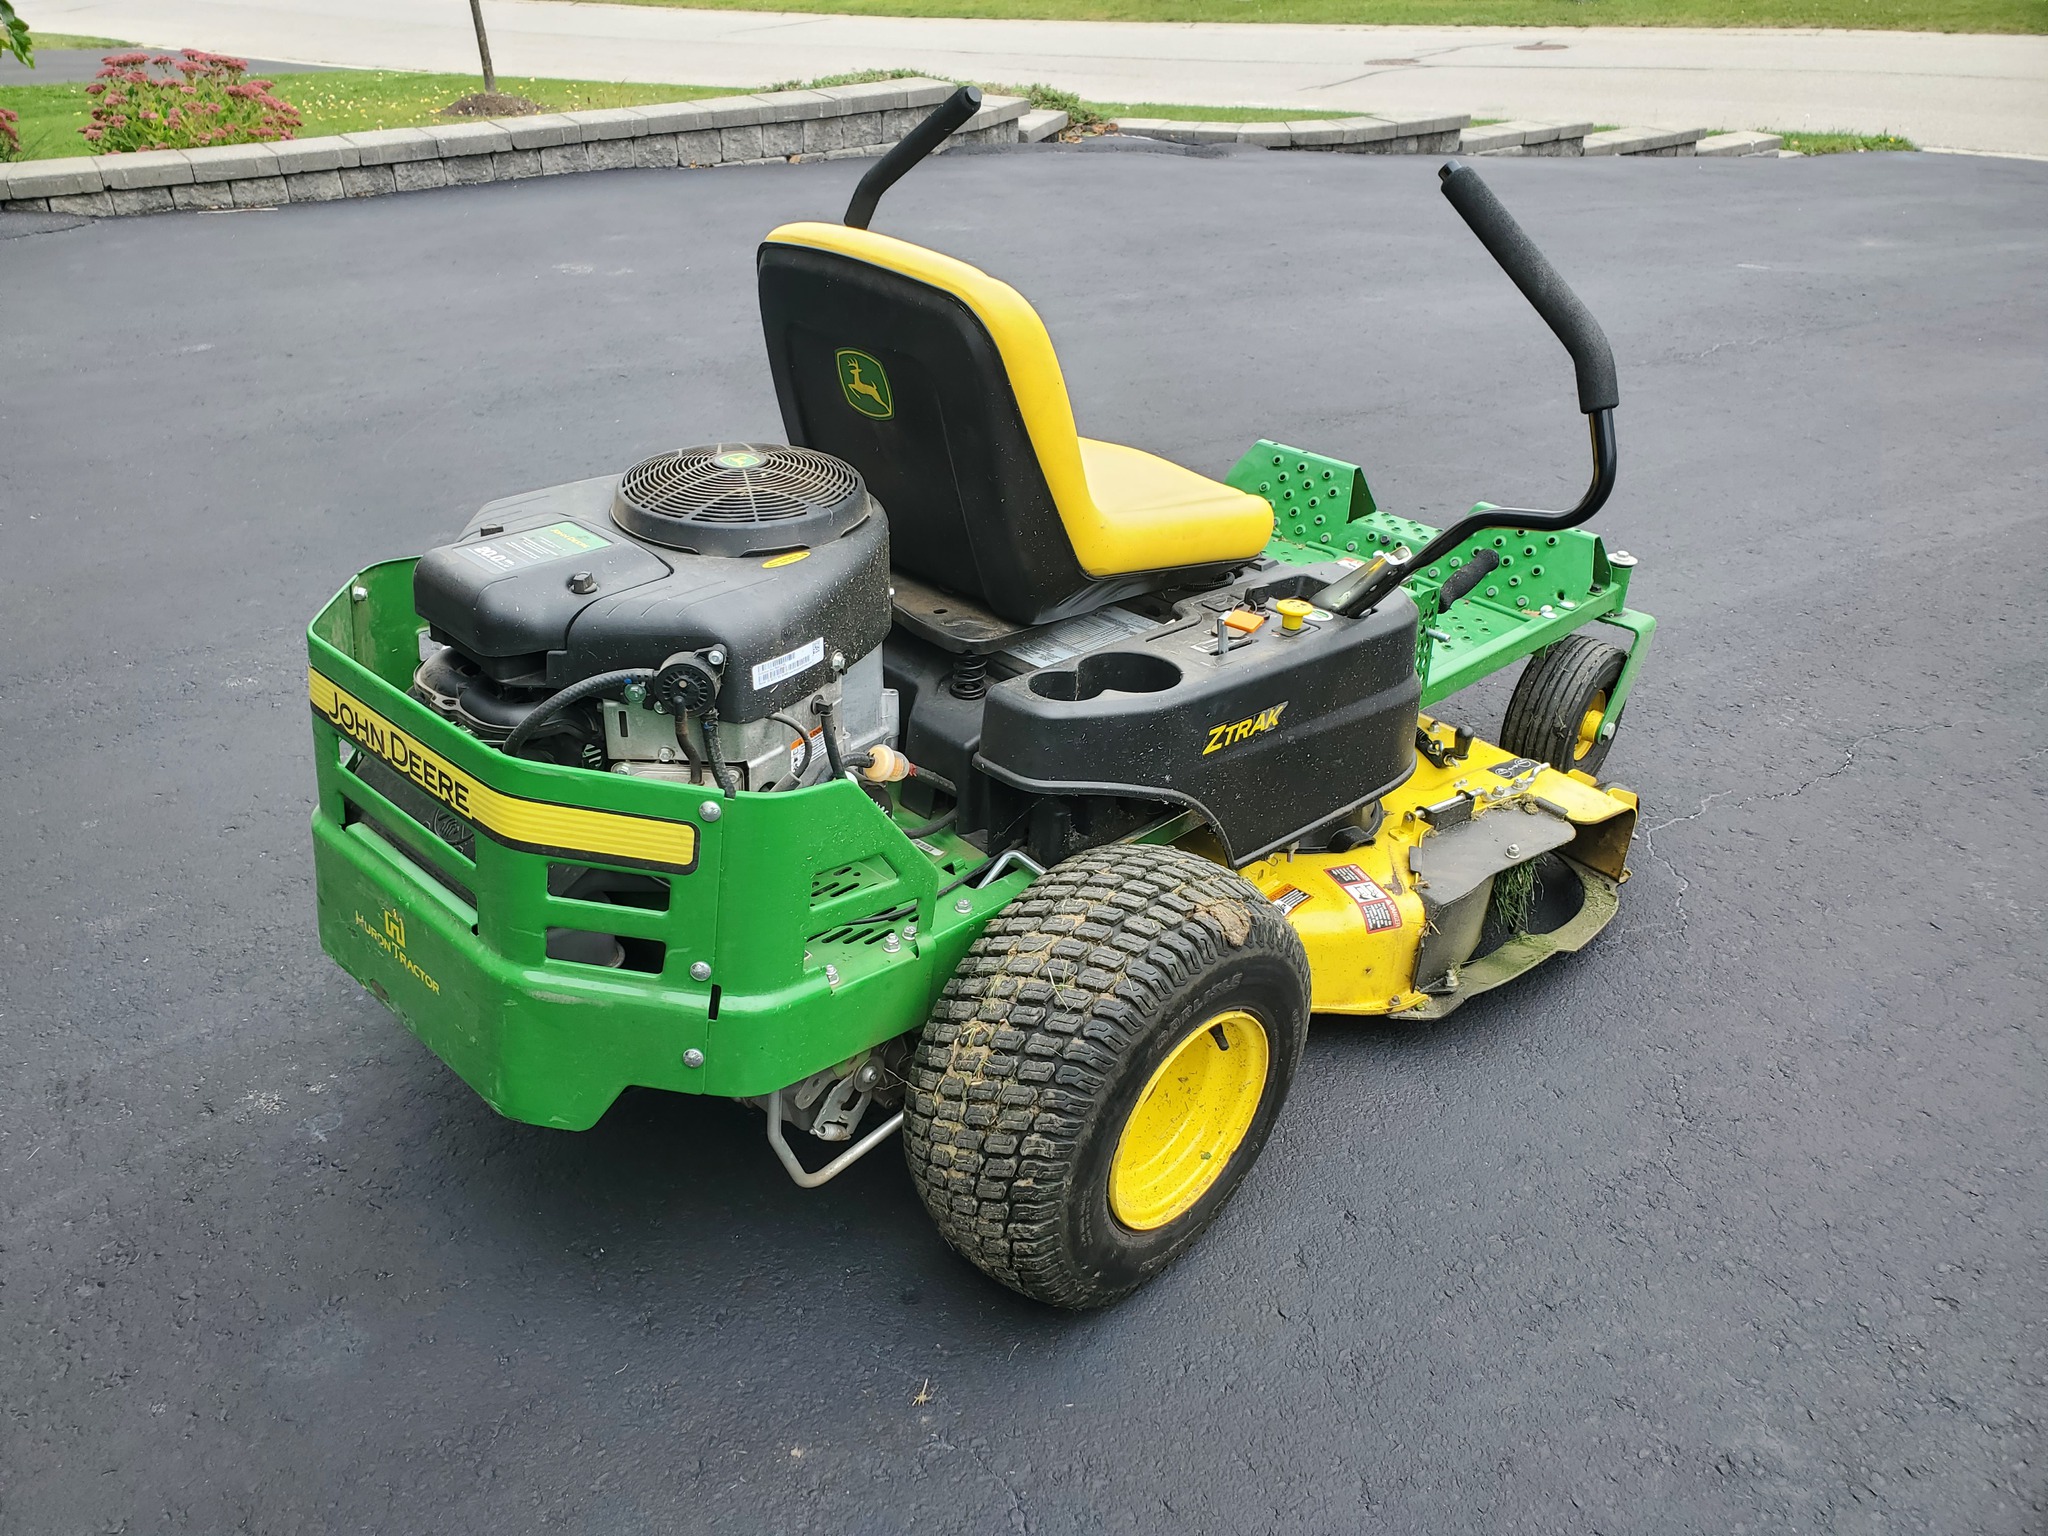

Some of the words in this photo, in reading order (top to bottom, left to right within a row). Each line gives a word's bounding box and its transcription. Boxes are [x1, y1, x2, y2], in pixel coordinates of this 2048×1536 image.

[328, 691, 387, 758] JOHN
[389, 731, 471, 816] DEERE
[1202, 704, 1285, 756] ZTRAK
[355, 909, 392, 953] HURON
[391, 941, 441, 996] TRACTOR
